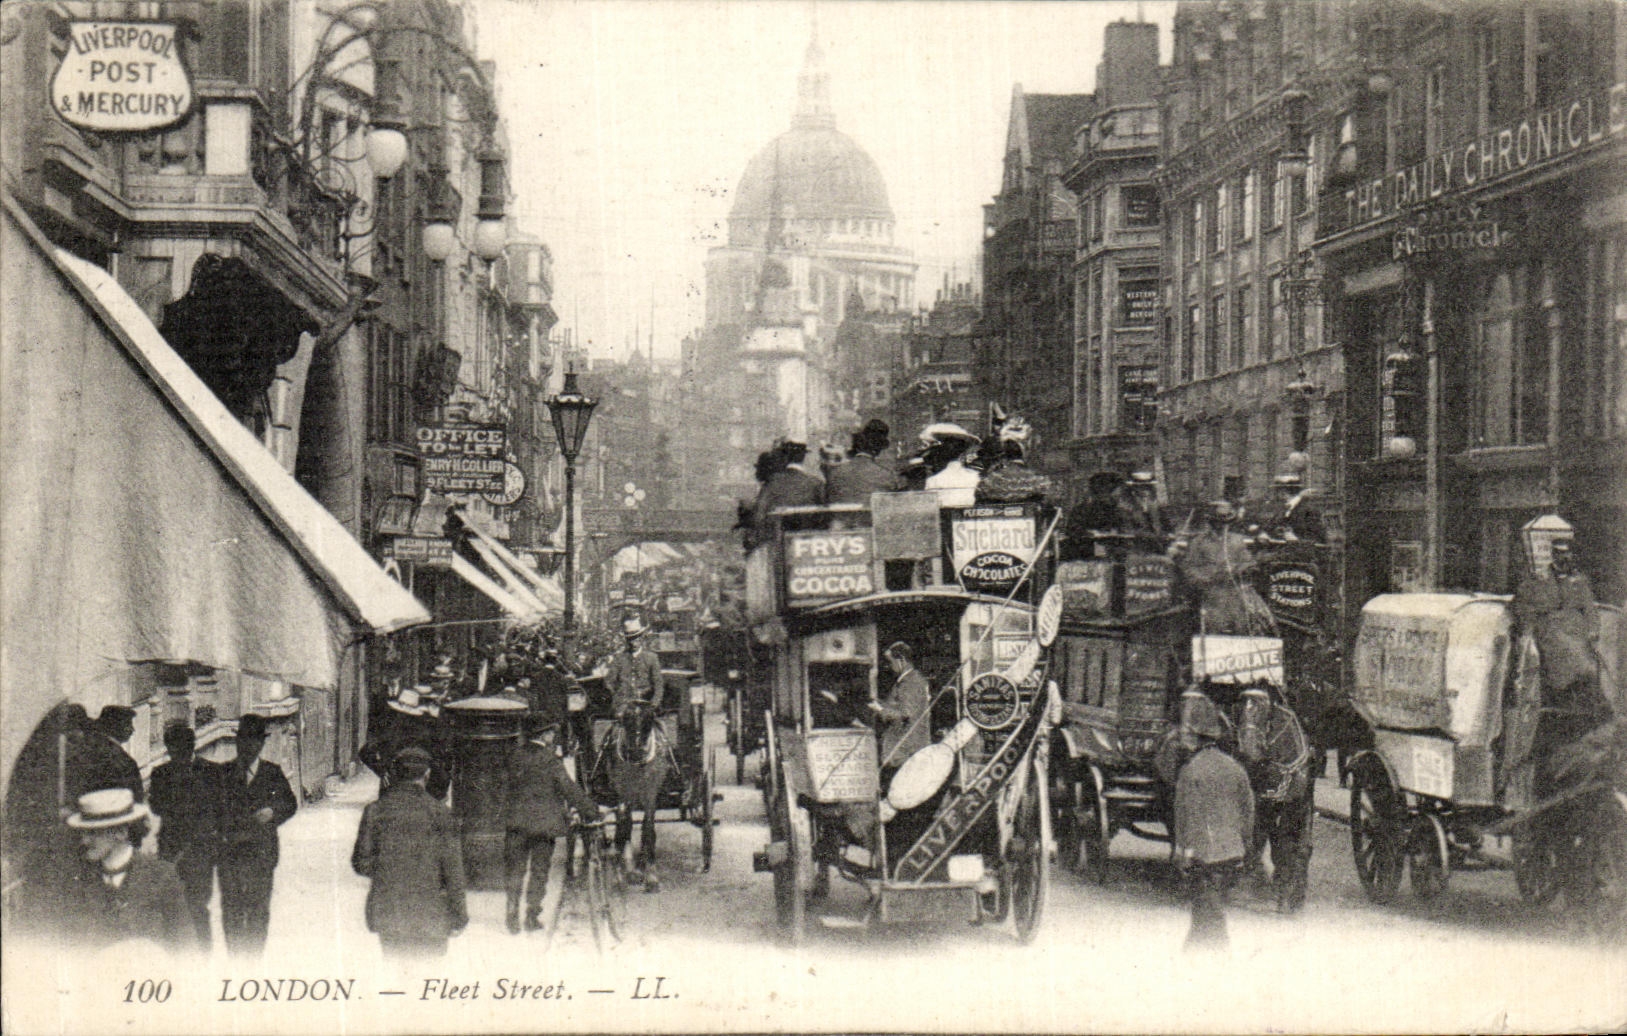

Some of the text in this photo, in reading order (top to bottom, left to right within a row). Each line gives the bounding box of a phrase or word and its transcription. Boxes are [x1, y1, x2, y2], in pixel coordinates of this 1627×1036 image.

[73, 26, 175, 59] LIVERPOOL
[90, 60, 157, 84] POST
[60, 91, 185, 117] & MERCURY
[1346, 83, 1625, 222] THE DAILY CHRONICLE
[416, 426, 505, 444] OFFICE
[417, 441, 447, 453] TO
[463, 443, 504, 456] LET
[424, 457, 452, 473] ENRY
[462, 459, 505, 474] COLLIER
[437, 477, 476, 490] FLEET
[956, 521, 1034, 551] Suchard
[976, 554, 1013, 568] COCOA
[790, 575, 873, 595] COCOA
[1270, 584, 1314, 596] STREET
[1198, 650, 1280, 676] HOCOLATE
[967, 676, 1015, 700] SANITAS
